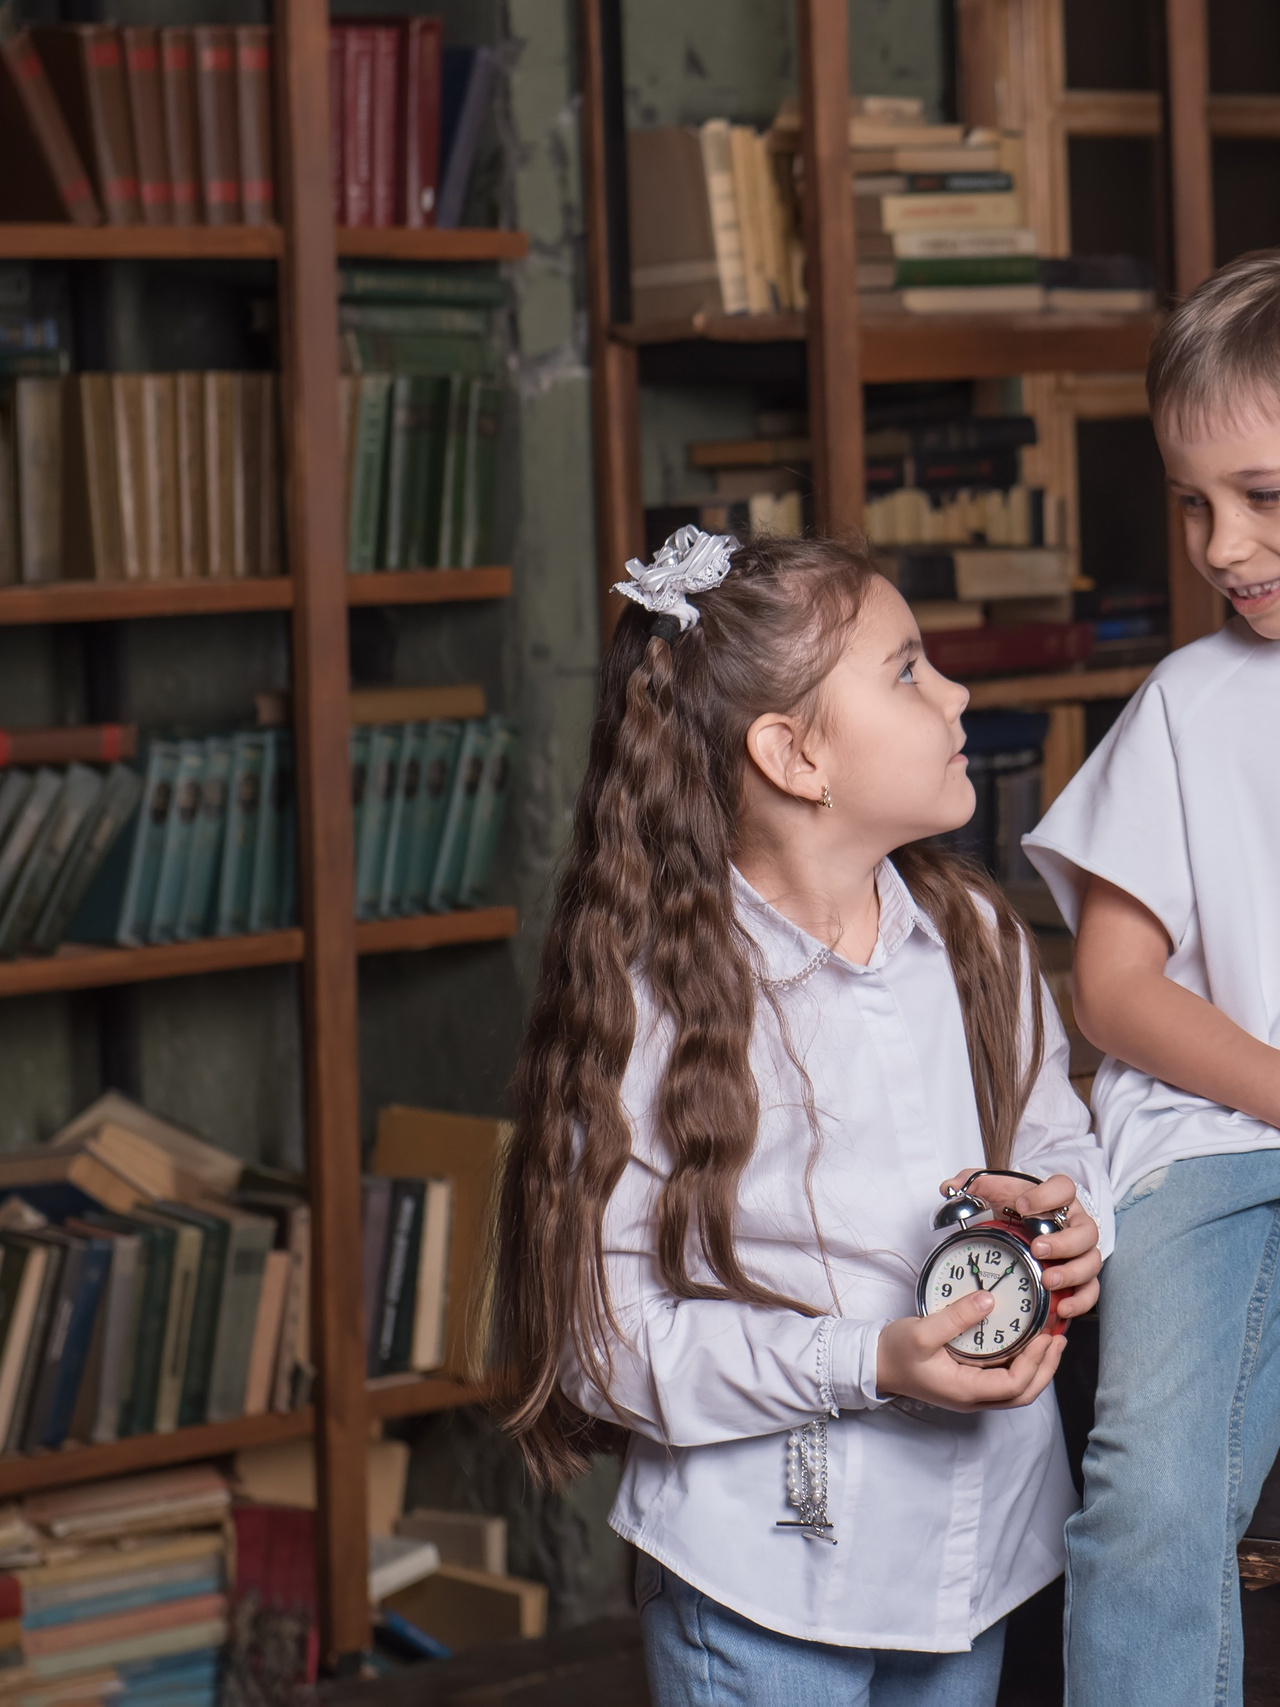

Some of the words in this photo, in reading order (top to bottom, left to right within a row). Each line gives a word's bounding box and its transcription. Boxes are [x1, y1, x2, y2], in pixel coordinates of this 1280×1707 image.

[967, 1252, 980, 1266] 11
[985, 1250, 1001, 1266] 12
[949, 1265, 964, 1280] 10
[941, 1284, 952, 1297] 9
[1018, 1277, 1030, 1292] 2
[1020, 1299, 1031, 1312] 3
[1009, 1318, 1020, 1332] 4
[974, 1332, 984, 1345] 6
[994, 1330, 1004, 1343] 5
